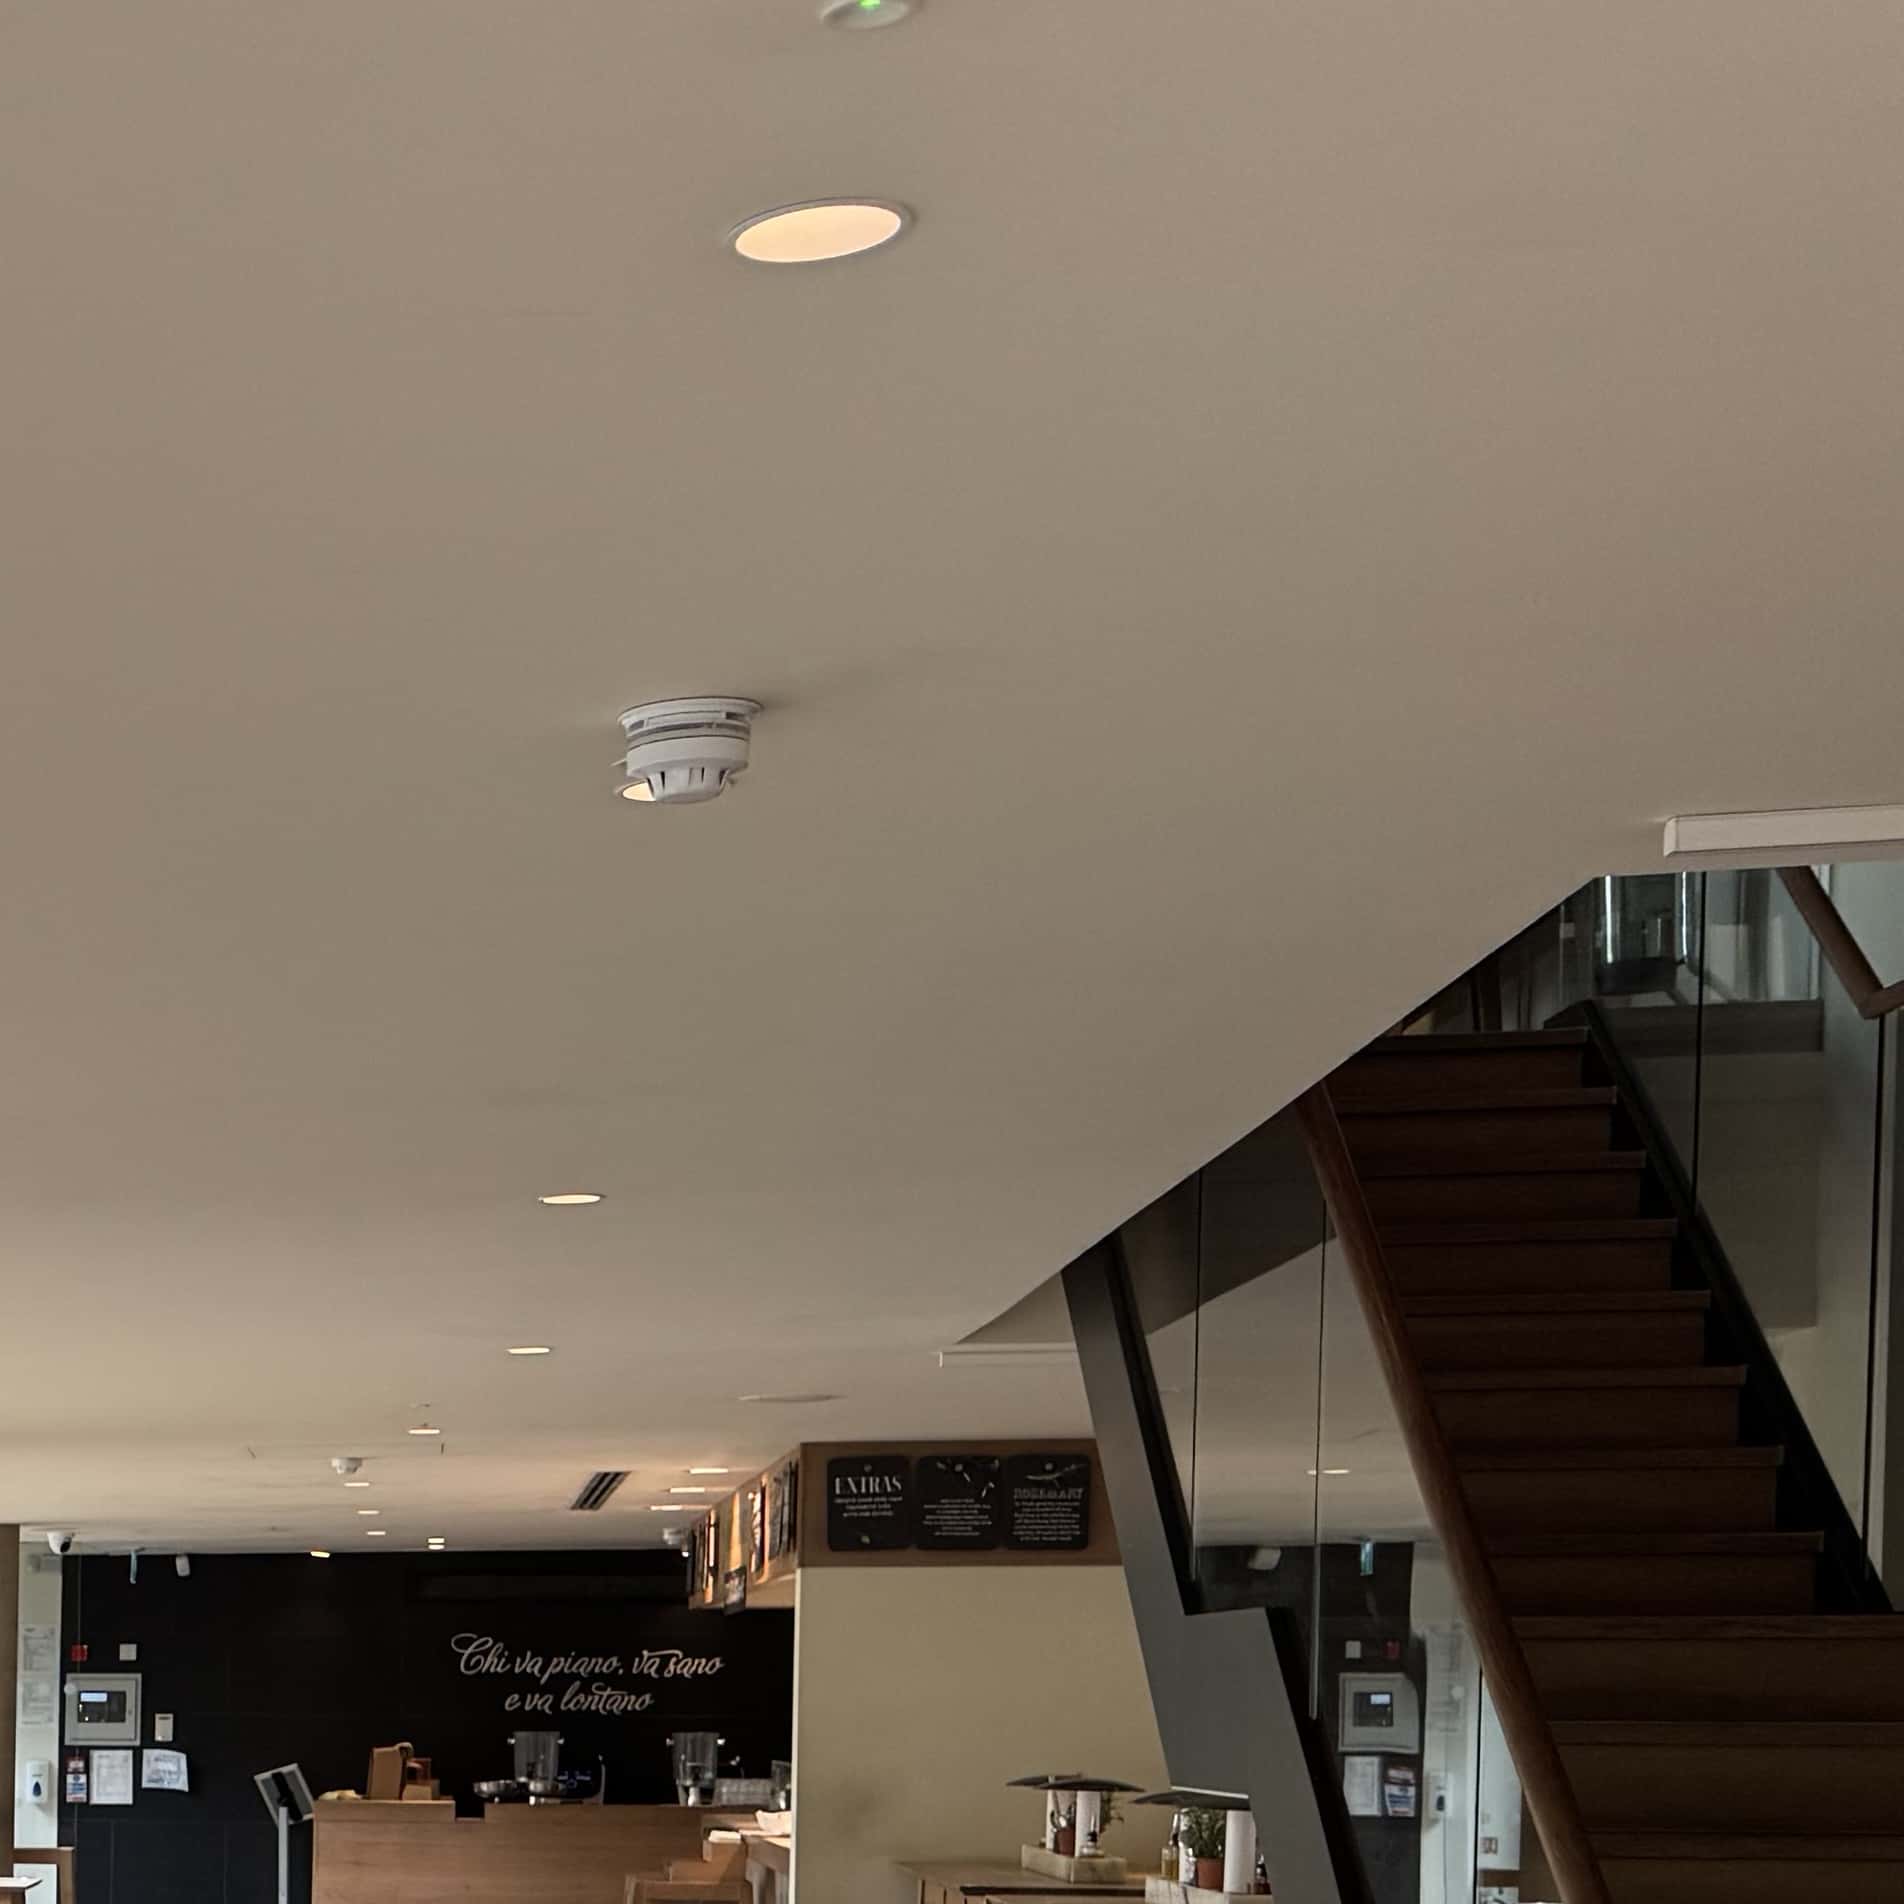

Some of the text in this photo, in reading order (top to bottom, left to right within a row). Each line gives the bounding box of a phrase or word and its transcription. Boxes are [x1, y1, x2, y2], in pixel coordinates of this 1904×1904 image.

[834, 1476, 902, 1495] EXTRAS
[451, 1633, 511, 1675] Chi
[514, 1650, 543, 1677] va
[632, 1649, 661, 1678] va
[663, 1649, 725, 1678] sano
[504, 1680, 655, 1715] e va lontano
